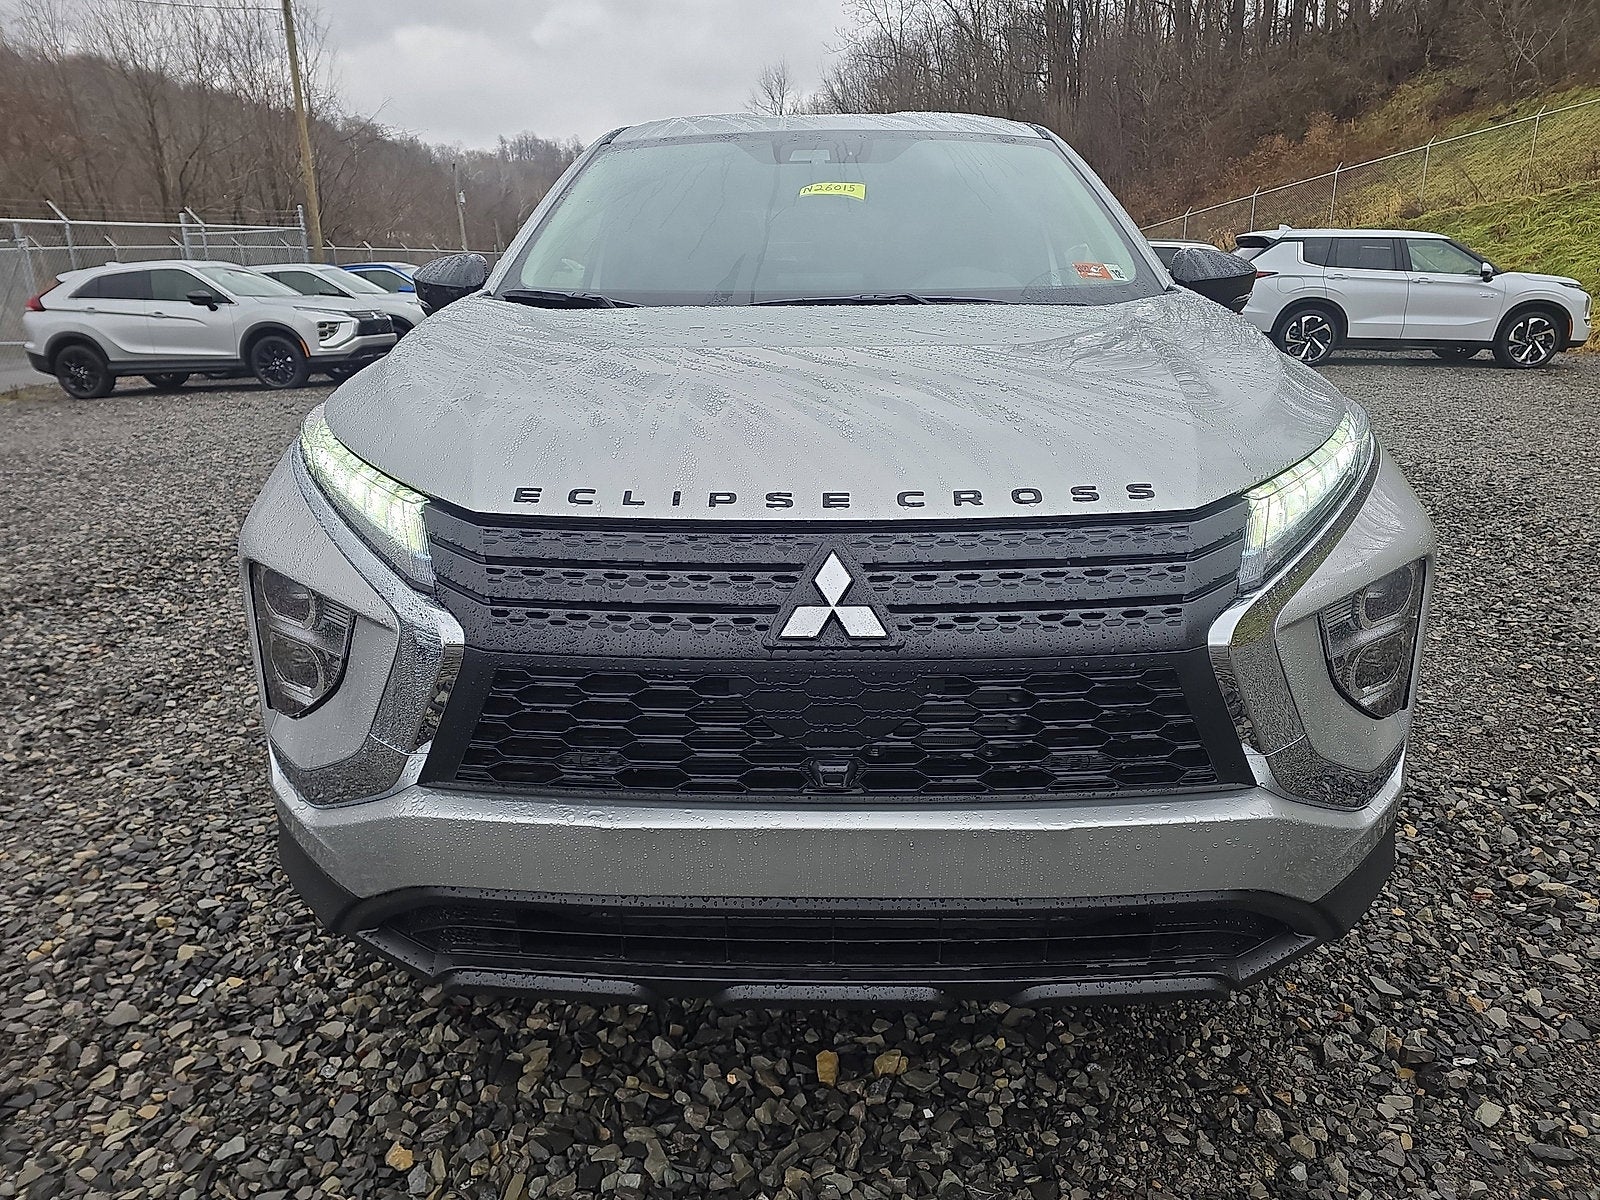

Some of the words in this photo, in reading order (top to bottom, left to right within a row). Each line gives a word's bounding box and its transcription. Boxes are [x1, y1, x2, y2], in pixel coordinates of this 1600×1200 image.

[802, 184, 856, 194] N26015
[513, 486, 851, 509] ECLIPSE
[896, 483, 1156, 508] CROSS
